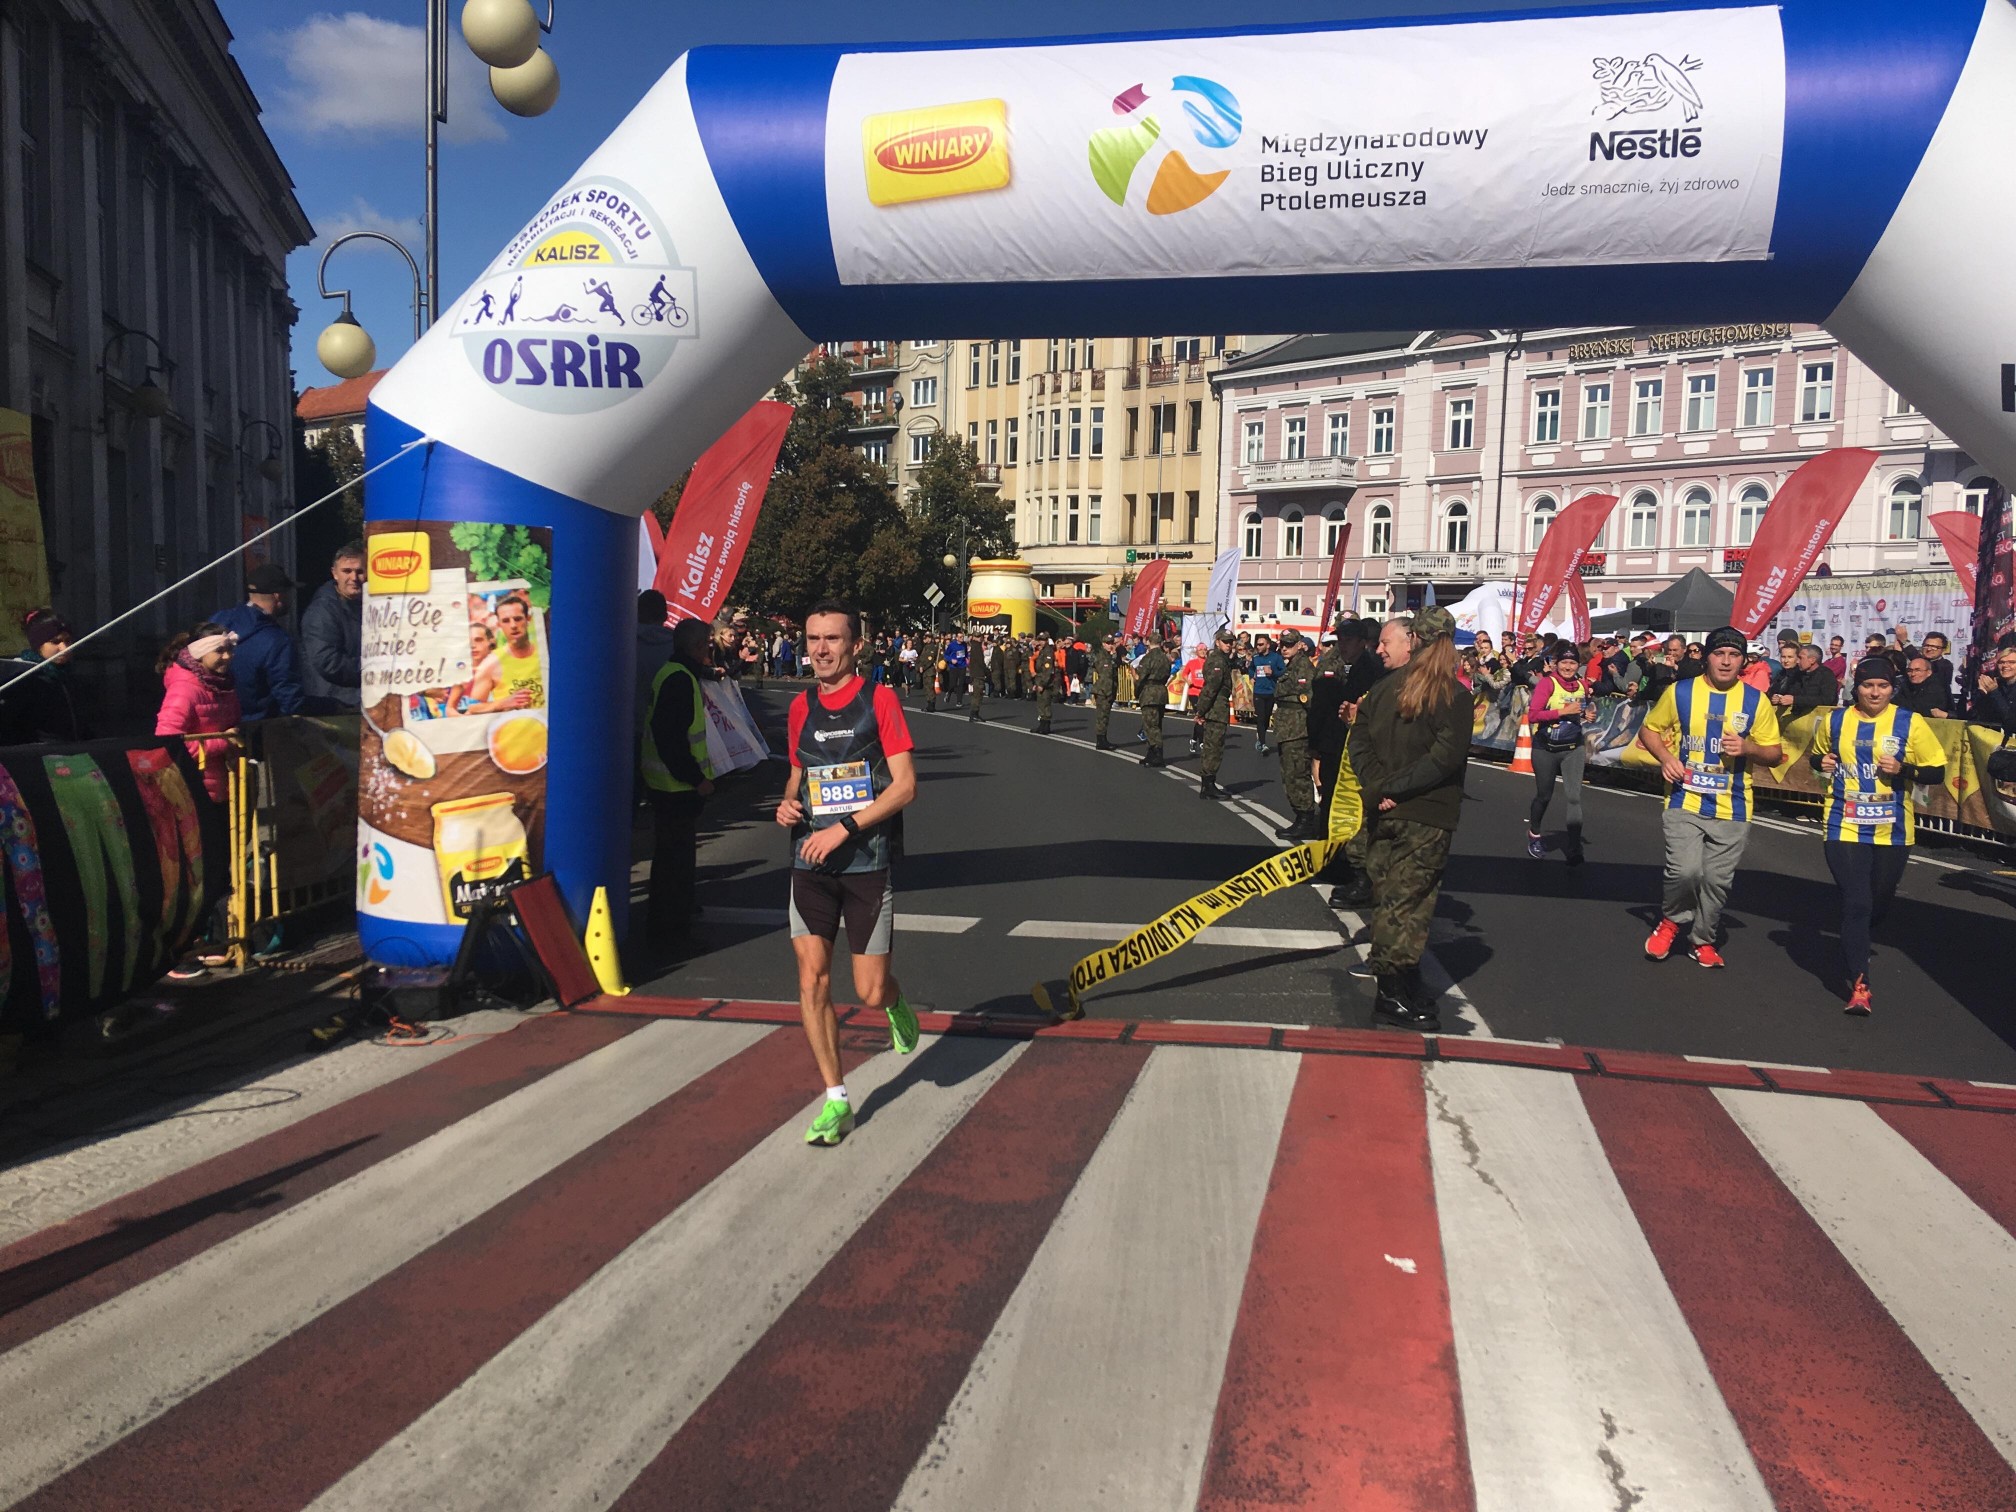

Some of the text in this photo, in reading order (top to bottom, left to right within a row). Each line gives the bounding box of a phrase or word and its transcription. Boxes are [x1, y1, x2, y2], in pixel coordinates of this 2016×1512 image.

[893, 131, 988, 167] WINIARY
[1261, 127, 1488, 158] Międzynarodowy
[1260, 158, 1424, 187] Bieg Uliczny
[1541, 177, 1740, 197] Jedz smacznie, żyj zdrowo
[1260, 188, 1427, 211] Ptolemeusza
[585, 189, 651, 242] SPORTU
[589, 208, 639, 260] REKREACJI
[534, 244, 600, 263] KALISZ
[483, 334, 644, 389] OSRiR
[1568, 337, 1636, 359] BRYŃSKI
[702, 481, 753, 607] Dopisz swoją historię
[1800, 519, 1830, 561] historię
[375, 554, 419, 573] WINIARY
[678, 532, 714, 600] Kalisz
[1564, 548, 1585, 580] historię
[1746, 566, 1787, 624] Kalisz
[1901, 578, 1946, 588] Ptolemeusza
[408, 597, 443, 632] Cię
[971, 604, 1000, 613] WINIARY
[1133, 607, 1145, 634] Kalisz
[1524, 584, 1552, 628] Kalisz
[380, 657, 446, 685] mecie!
[1681, 735, 1706, 753] ARKA
[821, 784, 855, 802] 988
[1692, 775, 1716, 787] 834
[829, 804, 853, 813] ARTUR
[1856, 806, 1884, 817] 833
[1279, 847, 1314, 882] BIEG
[1226, 861, 1279, 907] ULICZNY
[1197, 893, 1224, 910] im.
[1110, 904, 1206, 971] KLAUDIUSZA
